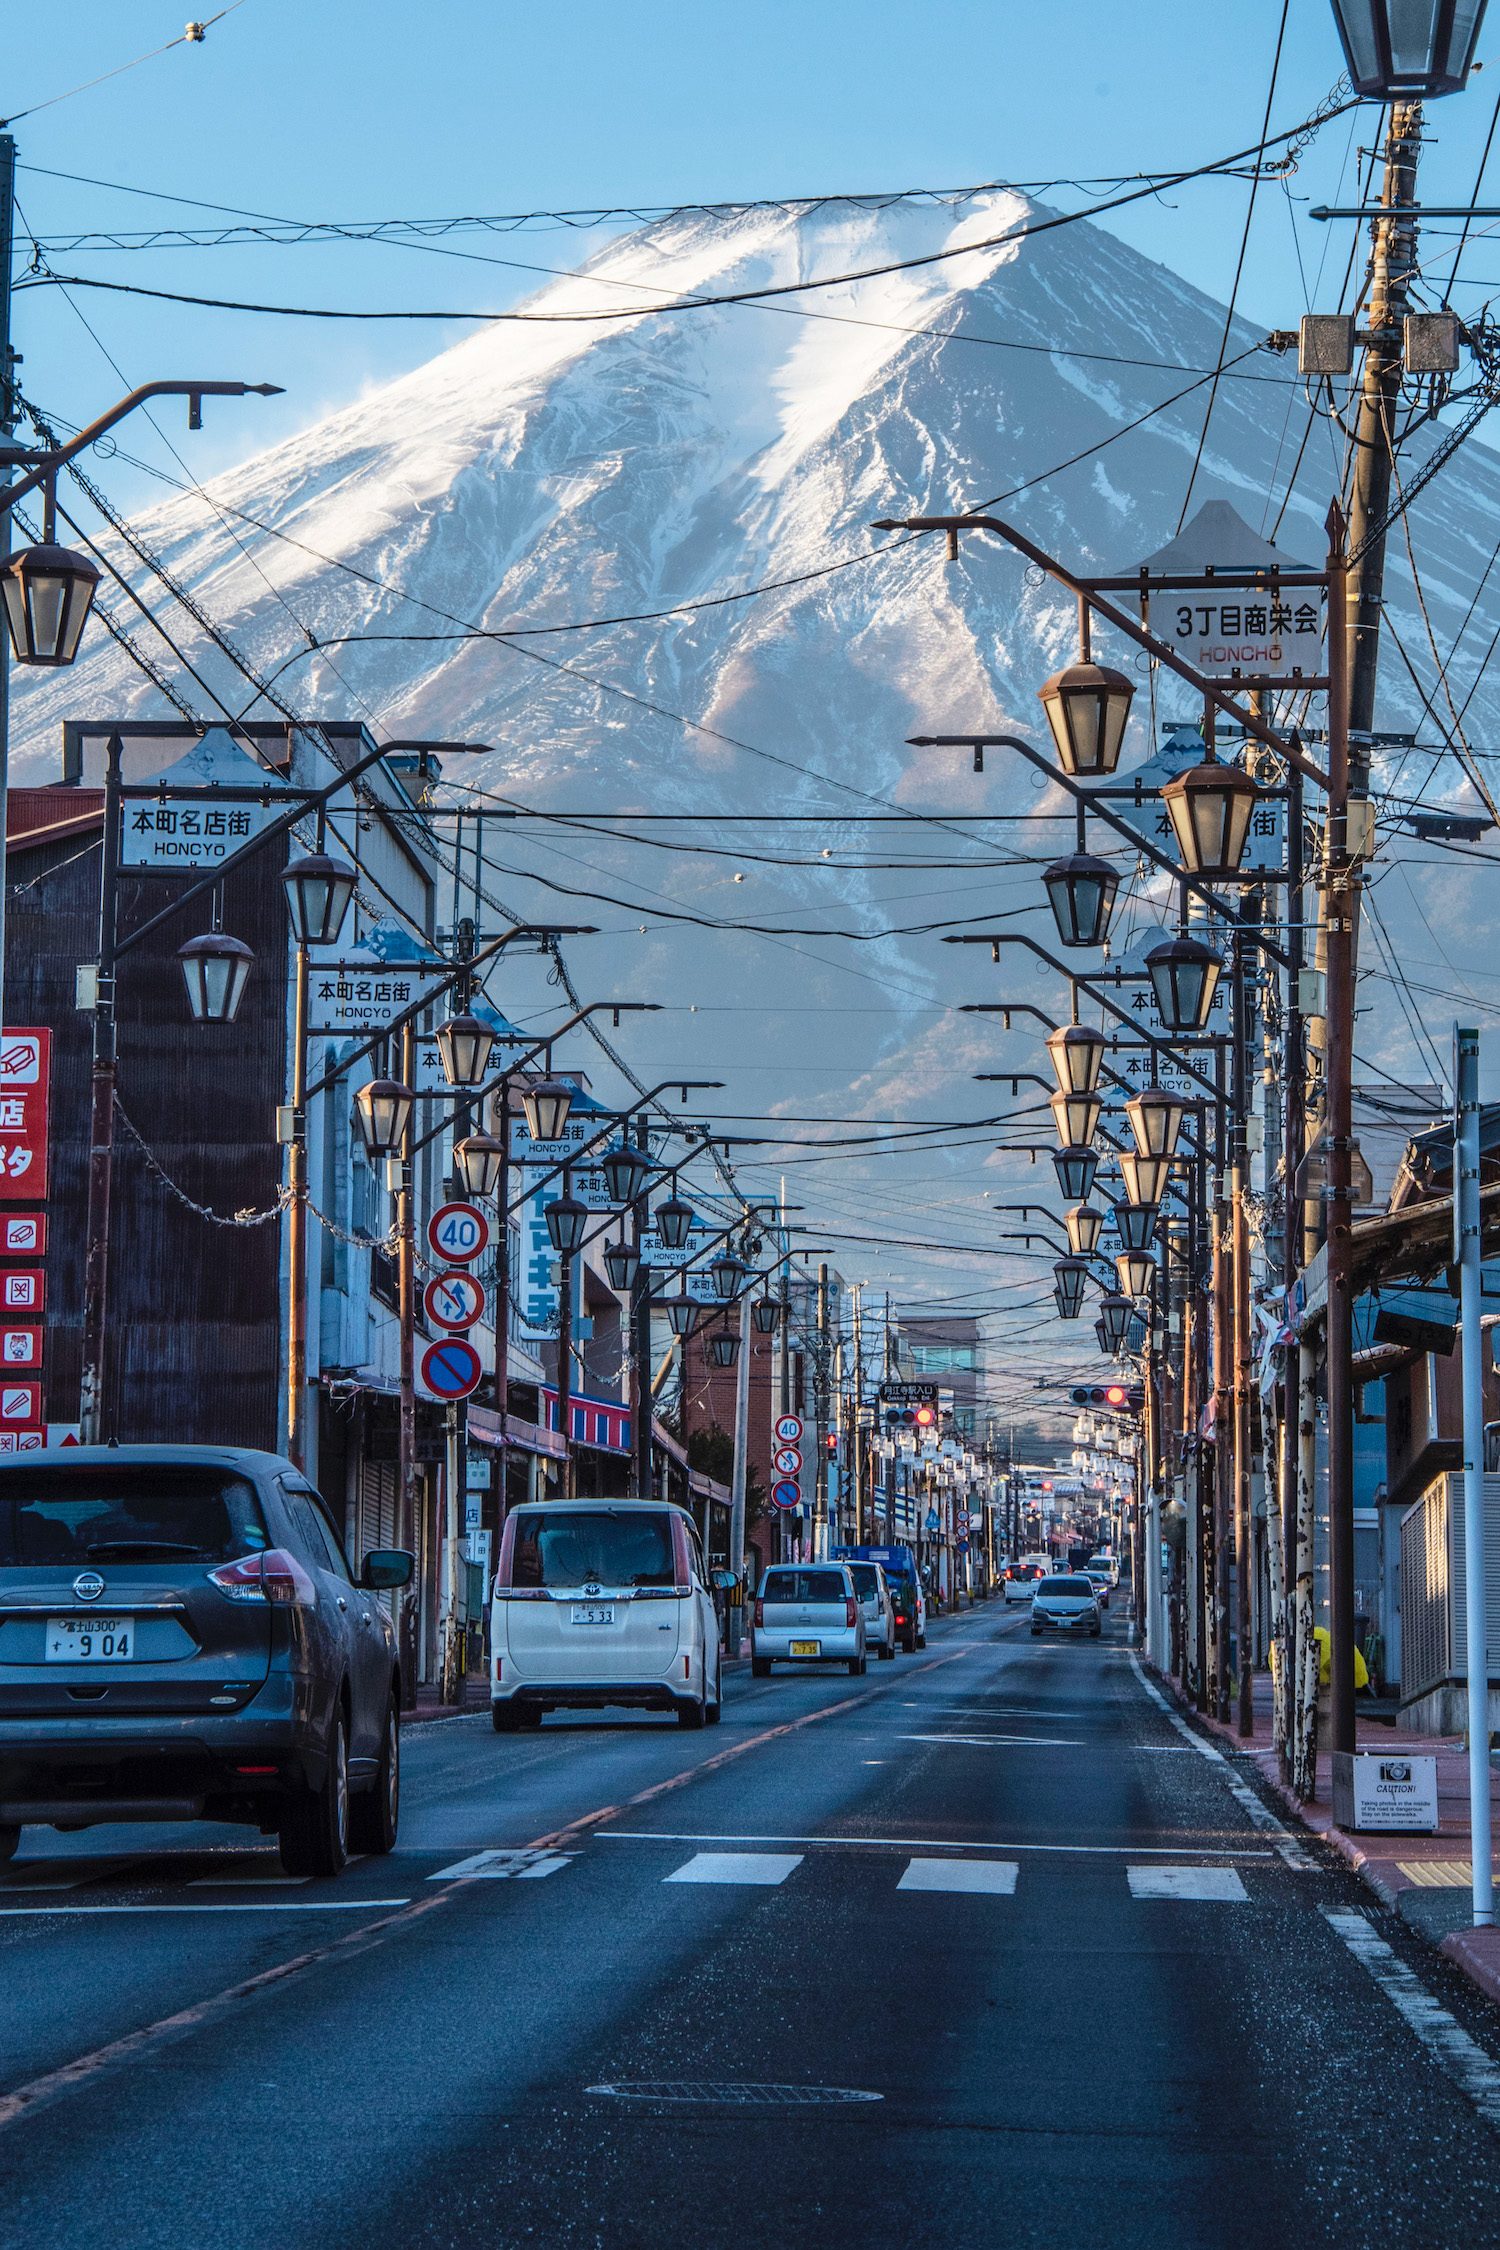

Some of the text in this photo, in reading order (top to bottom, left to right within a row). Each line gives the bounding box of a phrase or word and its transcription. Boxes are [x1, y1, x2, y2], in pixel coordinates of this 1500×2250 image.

[1176, 603, 1317, 637] 3丁目商栄会
[131, 808, 251, 836] 本町名店街
[318, 981, 411, 1003] 本町名店街
[442, 1221, 475, 1247] 40
[781, 1423, 798, 1437] 40
[1376, 1785, 1416, 1793] CAUTION!
